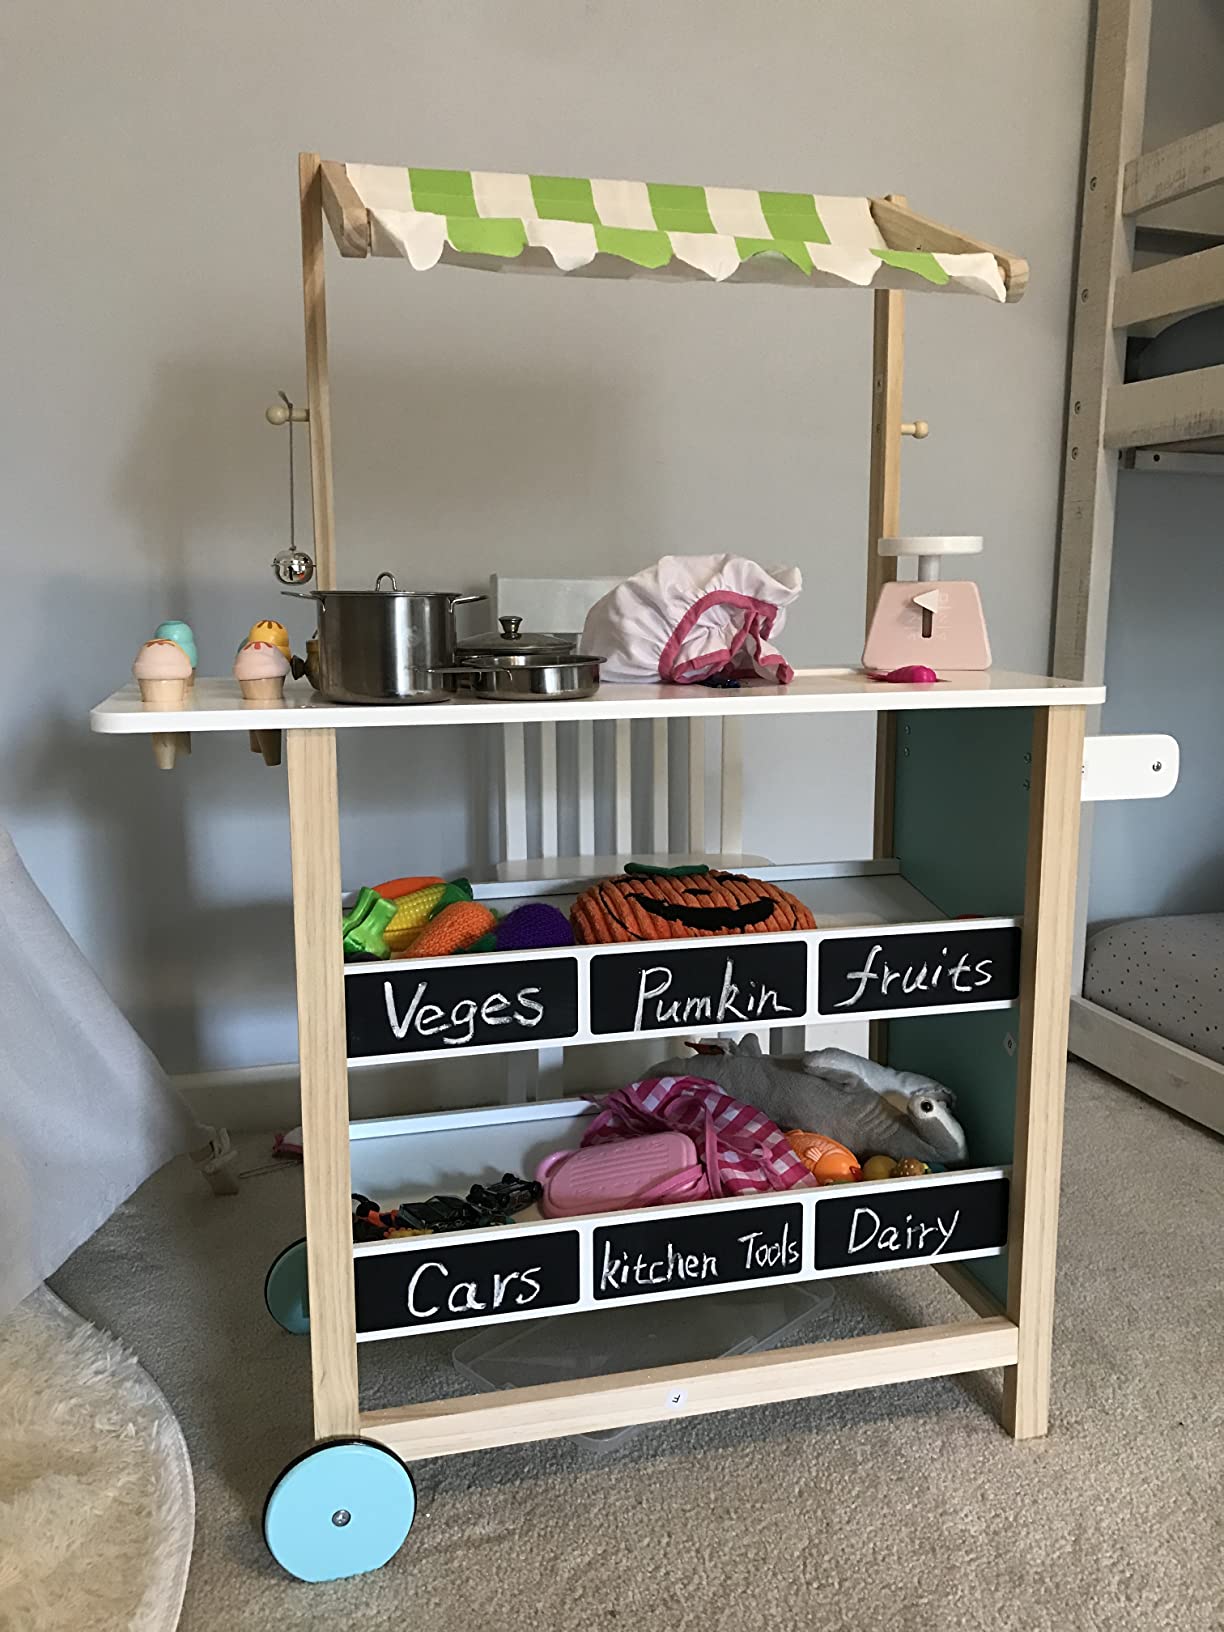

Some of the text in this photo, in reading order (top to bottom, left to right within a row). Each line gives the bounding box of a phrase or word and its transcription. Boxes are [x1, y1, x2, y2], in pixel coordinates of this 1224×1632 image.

[634, 959, 793, 1032] Pumkin
[834, 944, 993, 1007] fruits
[383, 981, 544, 1045] Veges
[600, 1223, 800, 1291] kitchen Tools
[848, 1207, 960, 1256] Dairy
[407, 1262, 542, 1318] Cars
